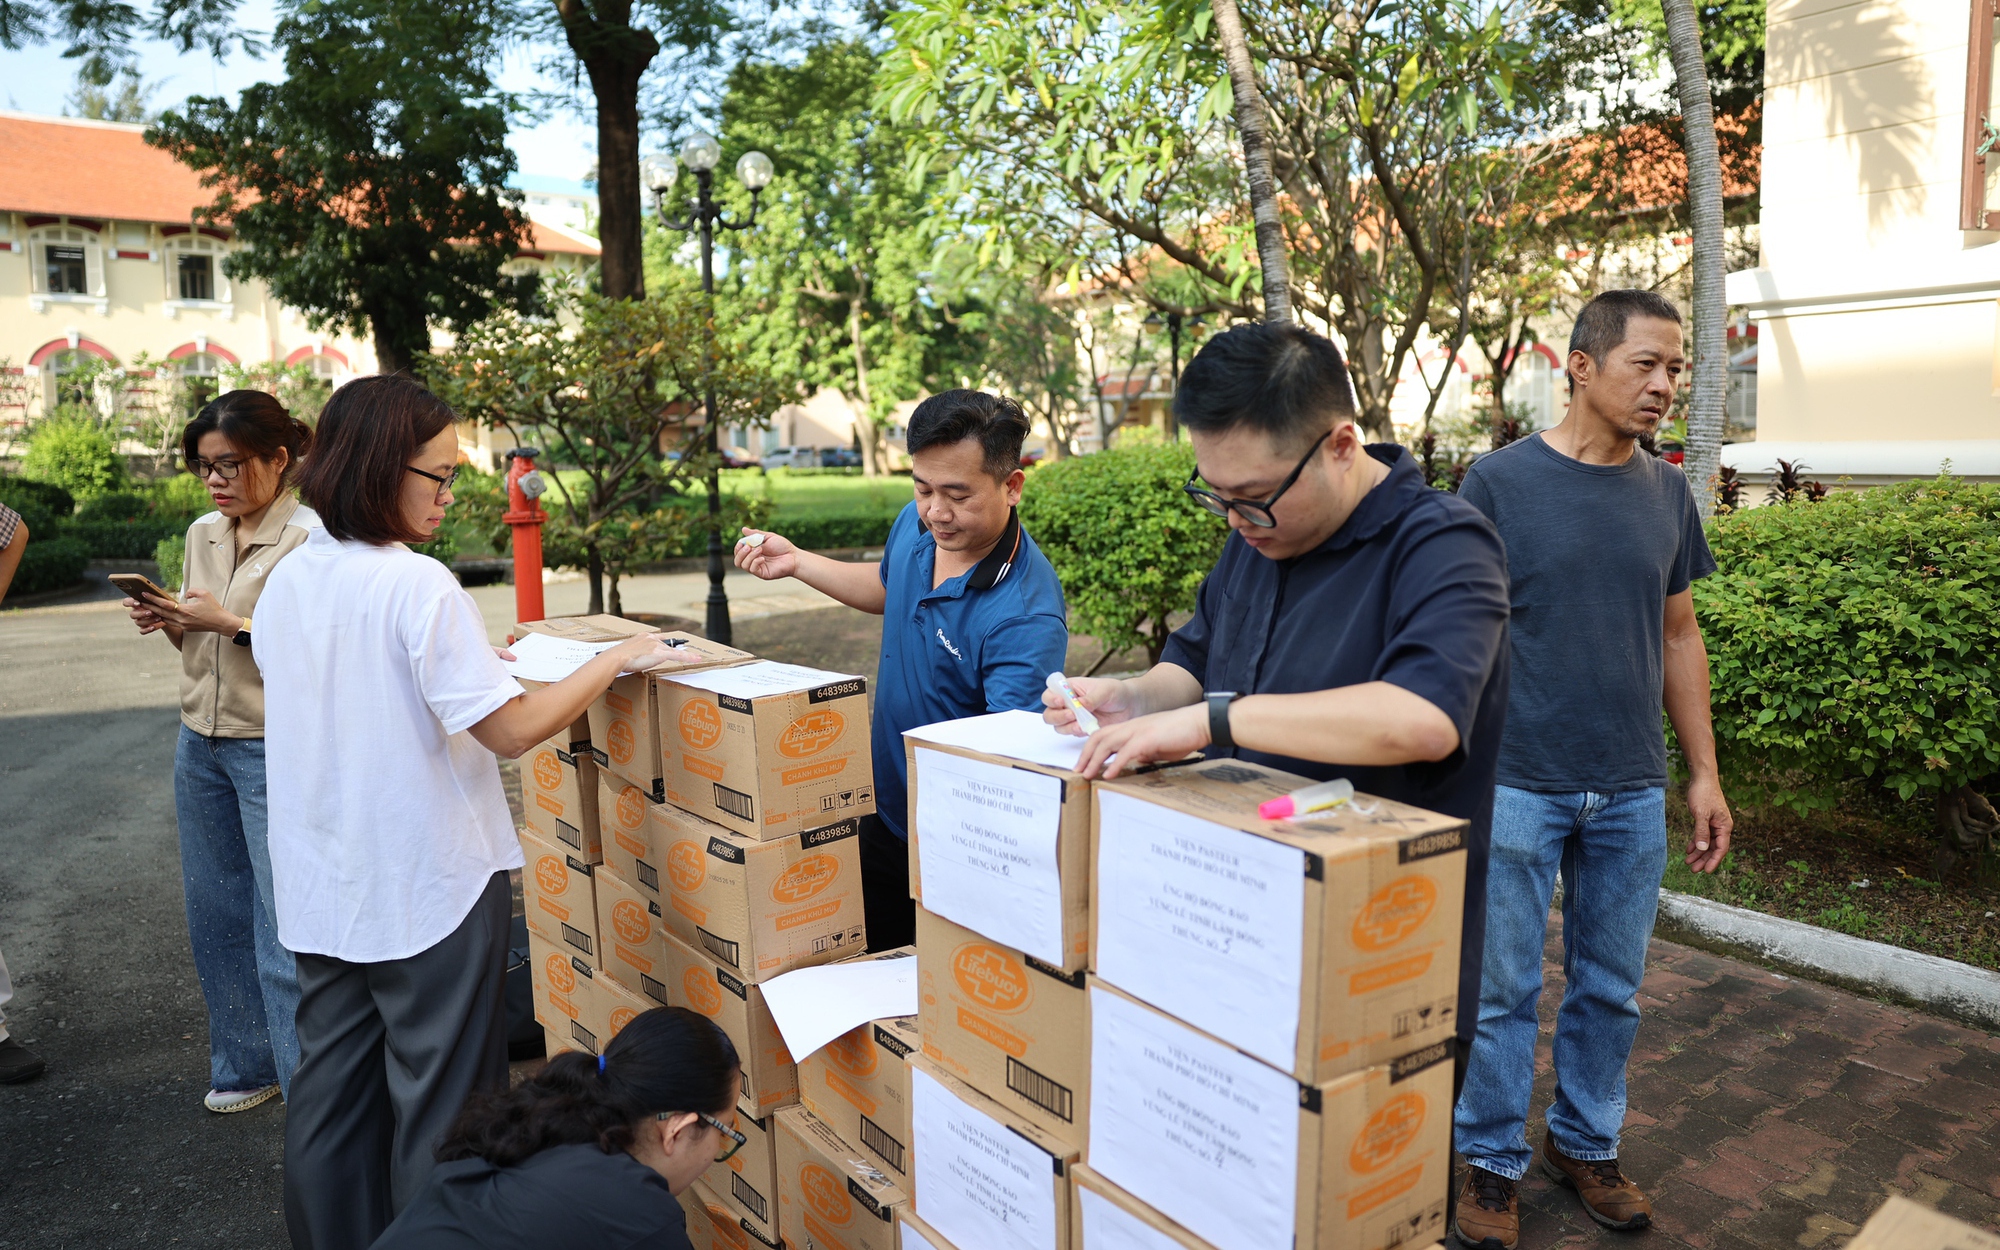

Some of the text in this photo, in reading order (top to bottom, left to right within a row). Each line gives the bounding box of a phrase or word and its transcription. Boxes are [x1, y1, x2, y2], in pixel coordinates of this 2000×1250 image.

[817, 682, 859, 698] 64839856
[682, 712, 719, 736] Lifebuoy
[784, 724, 840, 744] Lifebuoy
[787, 770, 812, 782] CHANH
[830, 762, 842, 773] MÙI
[810, 825, 851, 843] 64839856
[538, 864, 566, 888] Lifebuoy
[670, 852, 702, 881] Lifebuoy
[778, 868, 834, 890] Lifebuoy
[615, 908, 648, 936] Lifebuoy
[782, 914, 806, 926] CHANH
[824, 904, 836, 915] MÙI
[959, 955, 1023, 1000] Lifebuoy
[962, 1014, 988, 1037] CHANH
[804, 1170, 848, 1217] Lifebuoy
